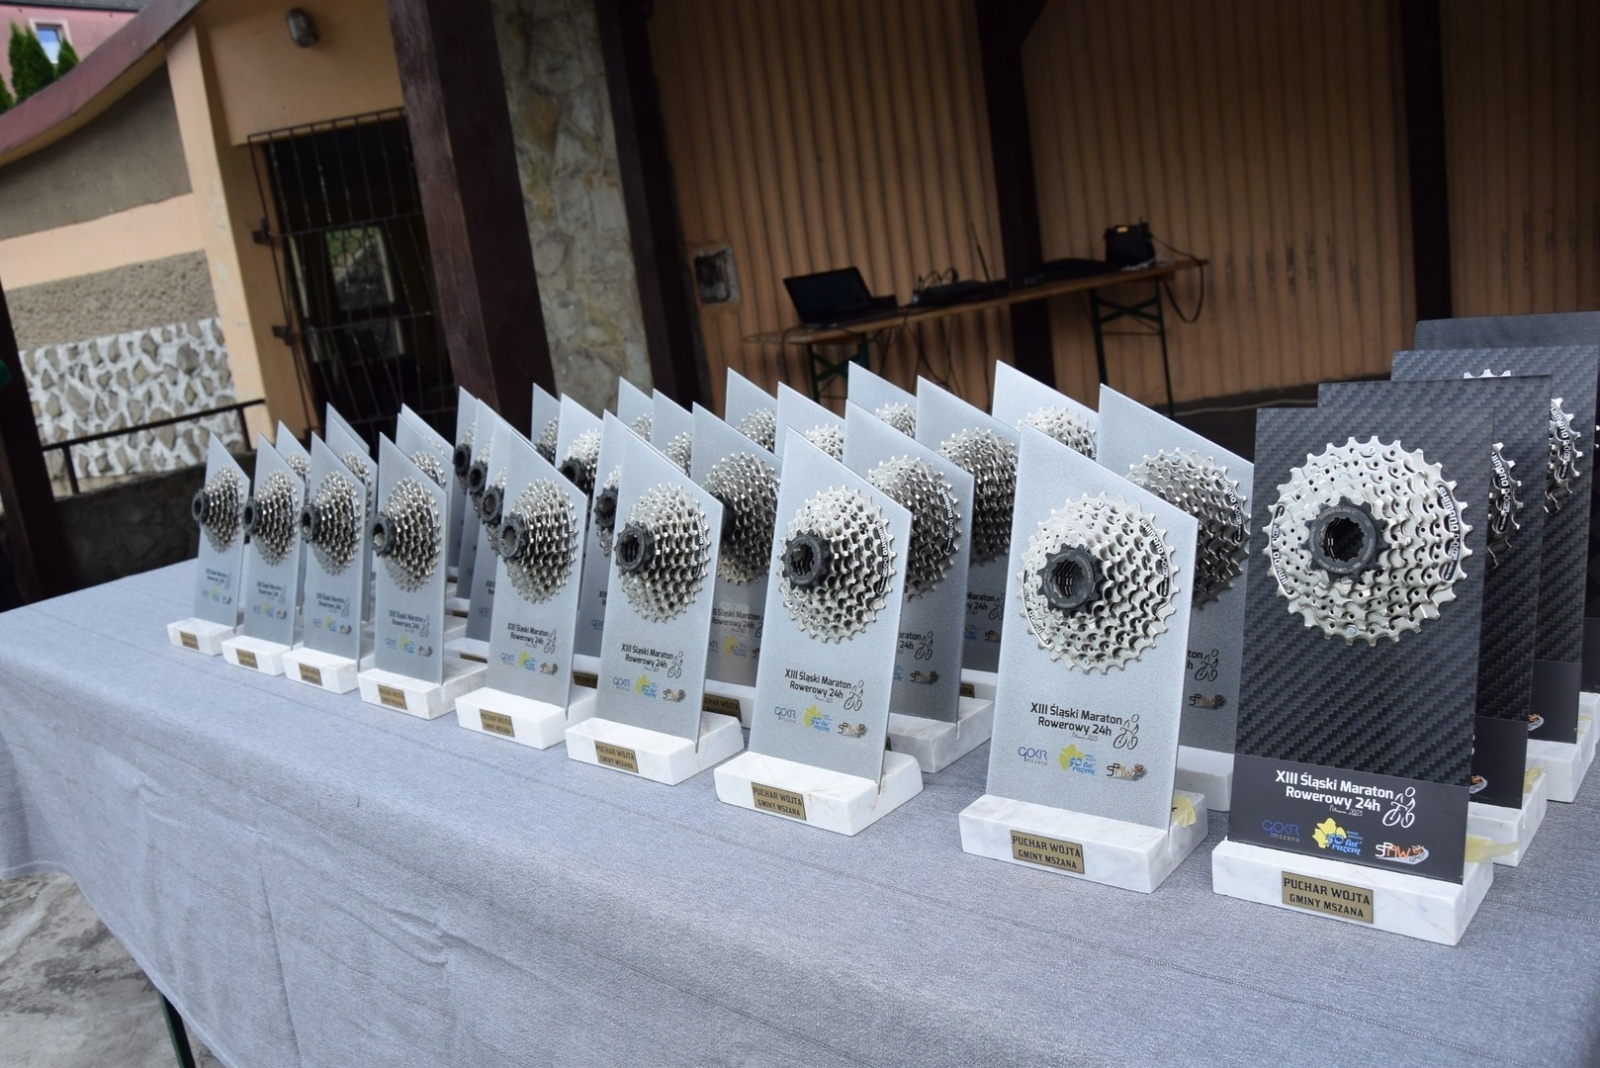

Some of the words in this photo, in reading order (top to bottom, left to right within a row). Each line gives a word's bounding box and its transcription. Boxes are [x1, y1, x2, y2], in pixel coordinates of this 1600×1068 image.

[1439, 486, 1459, 532] SHIMANO
[1140, 519, 1164, 554] SHIMANO
[898, 632, 922, 641] araton
[625, 653, 655, 668] Rowerowy
[656, 659, 668, 669] 24h
[650, 648, 674, 660] Maraton
[785, 668, 798, 679] XIII
[799, 669, 820, 683] Śląski
[821, 676, 851, 690] Maraton
[790, 680, 828, 698] Rowerowy
[829, 688, 843, 699] 24h
[1030, 702, 1048, 715] XIII
[1049, 703, 1079, 719] Śląski
[1081, 710, 1122, 725] Maraton
[1038, 716, 1090, 736] Rowerowy
[1092, 724, 1112, 736] 24h
[1275, 769, 1298, 785] XIII
[1300, 771, 1337, 790] Śląski
[1340, 780, 1394, 800] Maraton
[1285, 785, 1352, 811] Rowerowy
[1355, 796, 1380, 812] 24h
[1012, 835, 1048, 851] PUCHAR
[1018, 849, 1042, 861] GMINY
[1044, 854, 1077, 870] MSZANA
[1283, 877, 1328, 896] PUCHAR
[1289, 893, 1321, 908] GMINY
[1323, 900, 1364, 918] MSZANA
